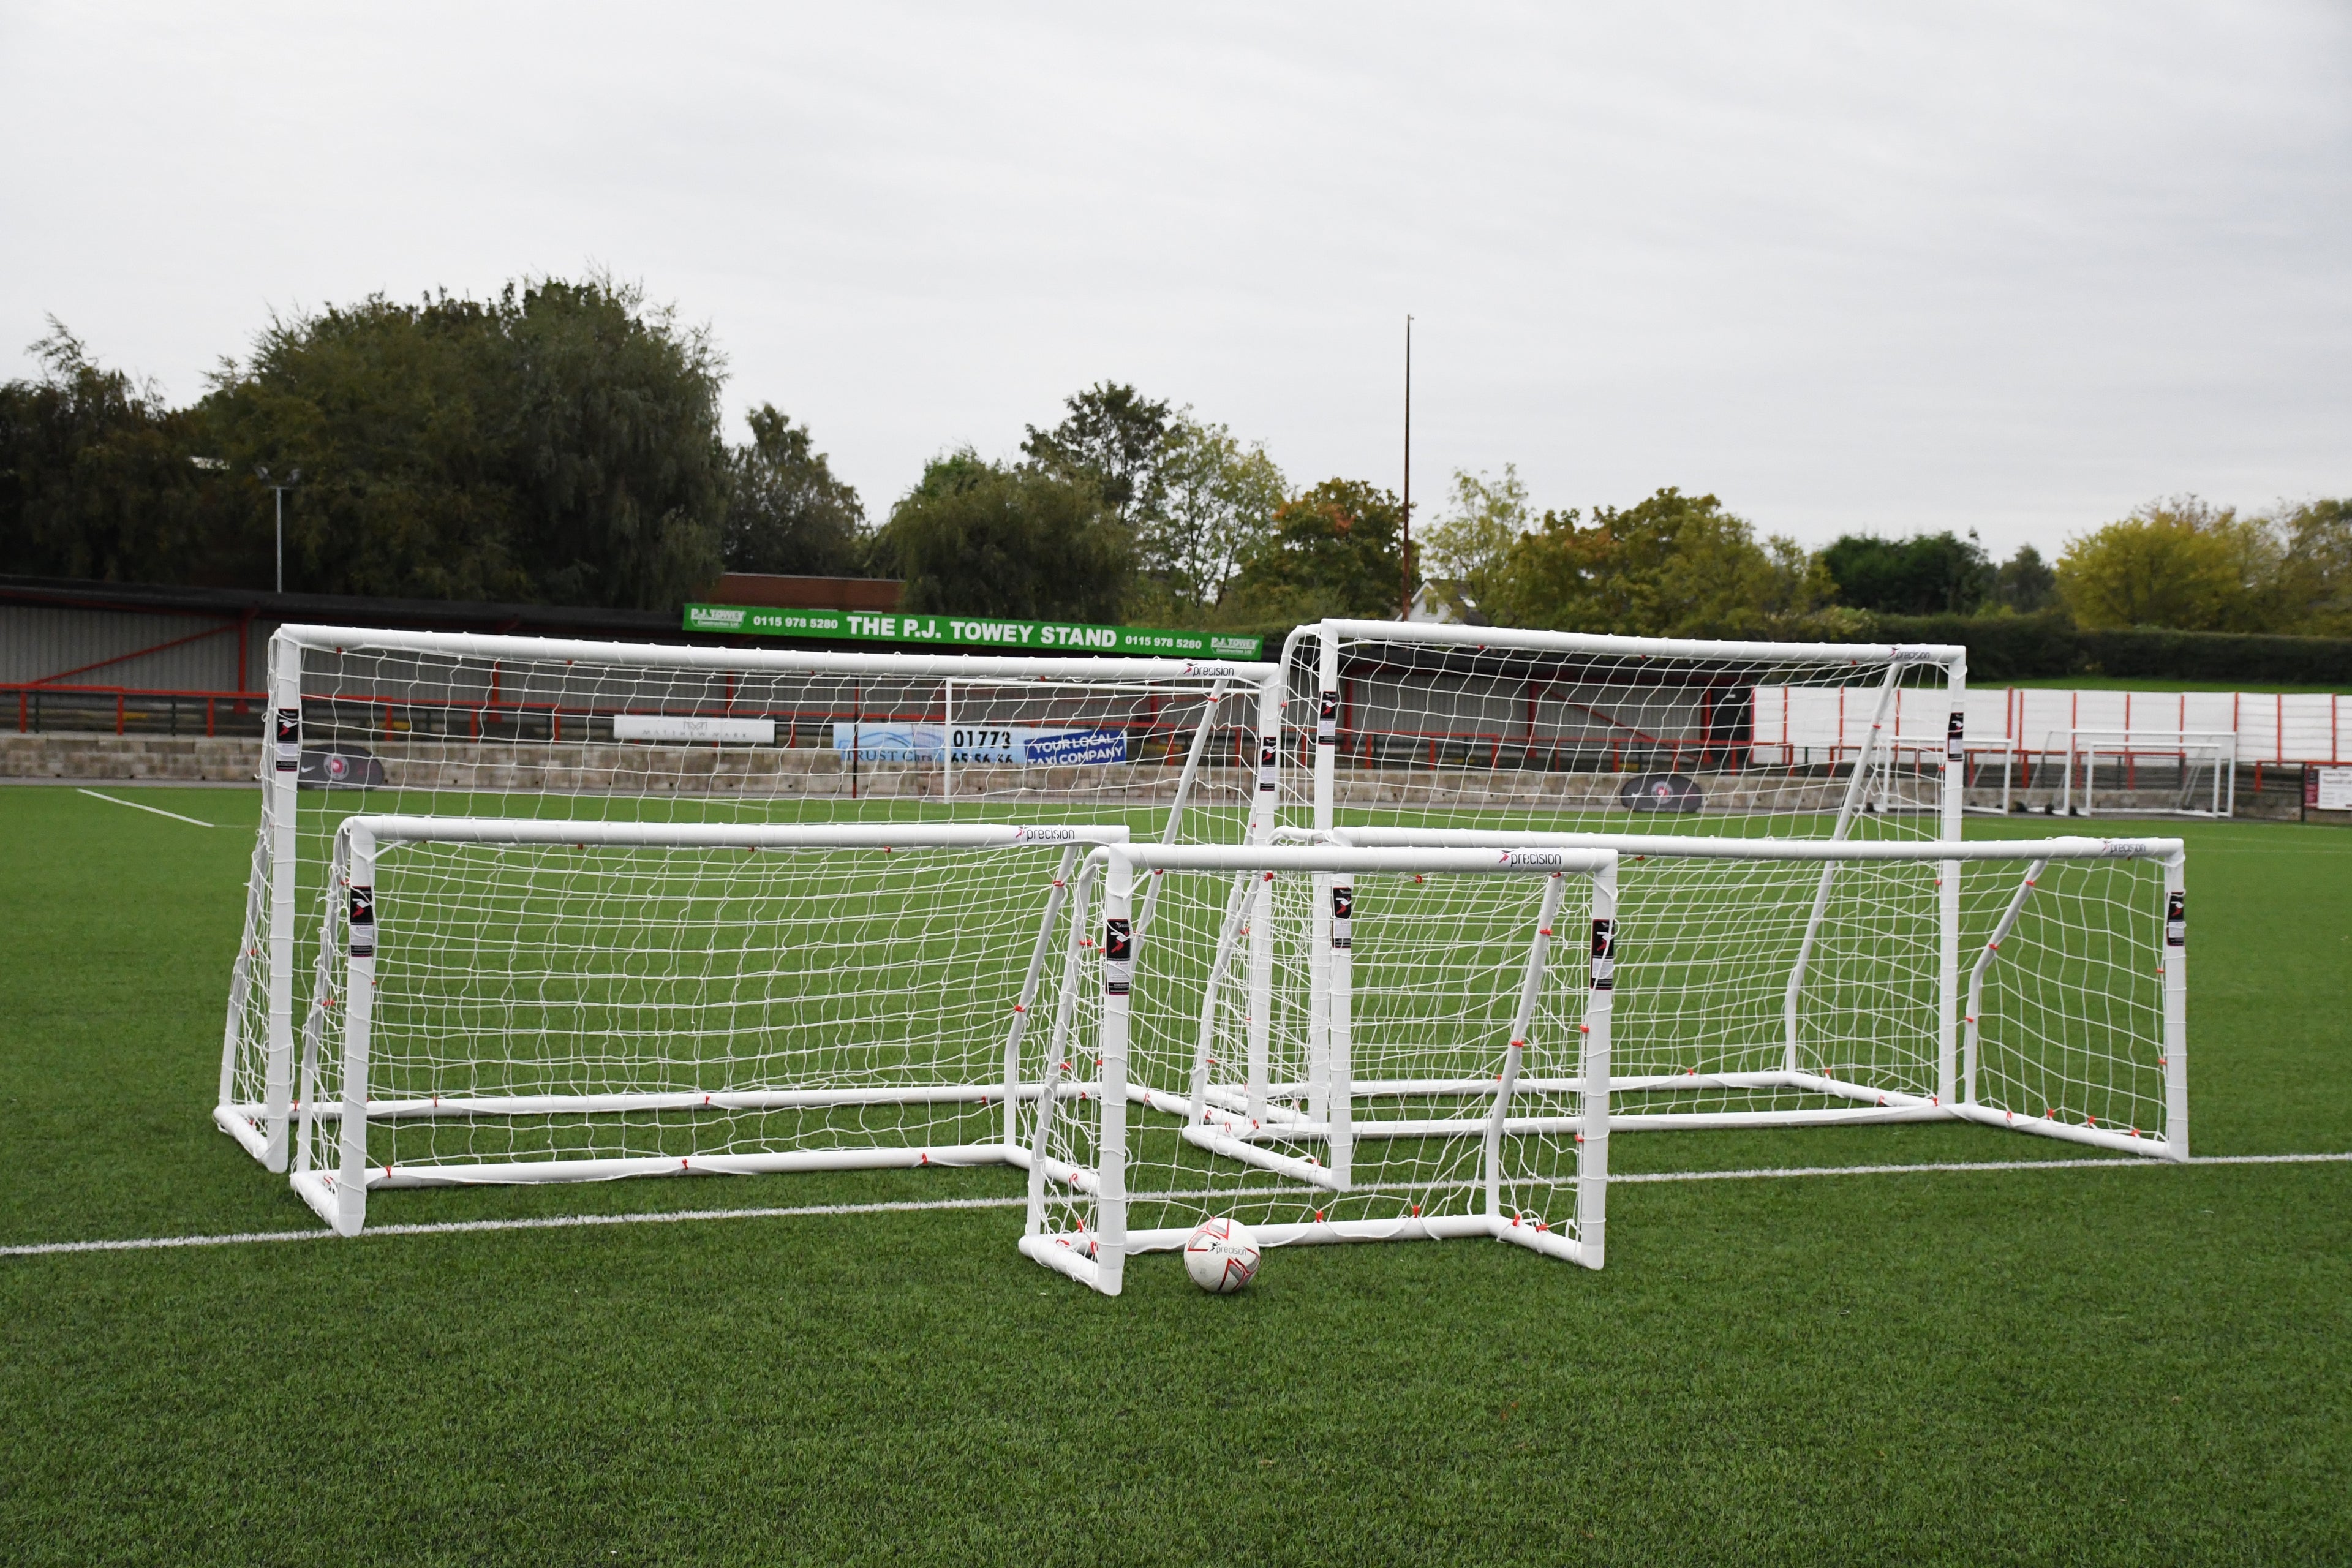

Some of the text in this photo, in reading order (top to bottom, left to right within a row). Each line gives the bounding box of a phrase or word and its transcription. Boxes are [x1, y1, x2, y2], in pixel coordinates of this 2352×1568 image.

[710, 609, 746, 621] TOWEY
[753, 616, 838, 629] 0115 978 5280
[846, 616, 1117, 647] THE P.J. TOWEY STAND
[1125, 635, 1202, 649] 0115 978 5280
[1227, 638, 1259, 650] TOWEY
[1896, 651, 1929, 660] precision
[1193, 666, 1234, 676] precision
[954, 729, 1010, 749] 01773
[1034, 733, 1115, 753] YOUR LOCAL
[843, 750, 897, 761] TRUST
[1059, 746, 1123, 764] COMPANY
[1027, 828, 1075, 842] precision
[2110, 843, 2146, 853] precision
[1510, 852, 1561, 867] precision
[1216, 1245, 1246, 1256] precision
